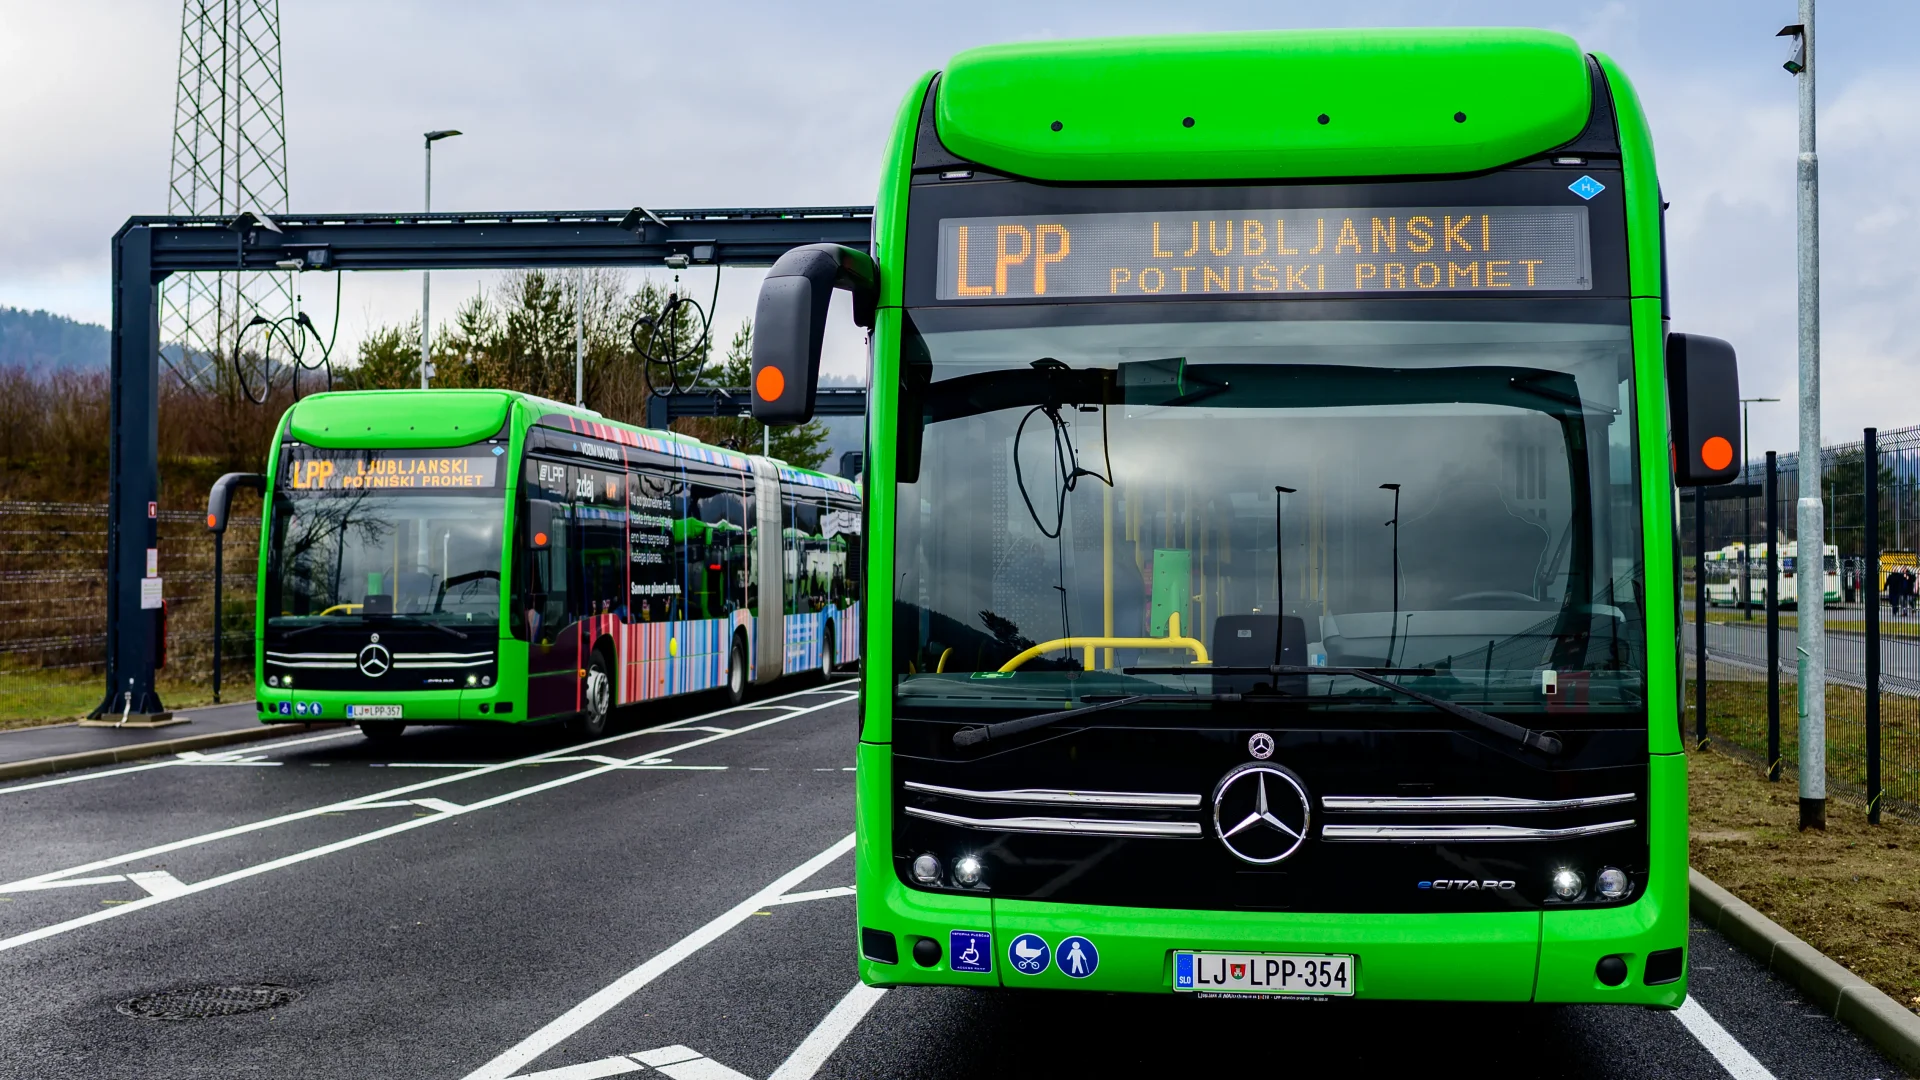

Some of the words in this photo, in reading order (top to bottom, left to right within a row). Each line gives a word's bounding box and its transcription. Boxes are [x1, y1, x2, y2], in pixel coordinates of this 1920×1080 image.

[1153, 214, 1490, 258] LJUBLJANSKI
[957, 224, 1070, 296] LPP
[1110, 259, 1325, 293] POTNIŠKI
[1355, 259, 1543, 289] PROMET
[293, 460, 334, 489] LPP
[357, 459, 468, 476] LJUBLJANSKI
[548, 465, 564, 483] LPP
[343, 474, 415, 488] POTNIŠKI
[422, 475, 484, 487] PROMET
[576, 473, 595, 503] zdaj
[630, 491, 637, 506] To
[631, 532, 639, 544] eno
[631, 581, 645, 595] Samo
[645, 584, 651, 595] en
[651, 581, 666, 597] planet
[353, 707, 365, 716] LJ
[370, 706, 400, 717] LPP-357
[1417, 879, 1516, 891] eCITARO
[1179, 975, 1191, 985] SLO
[1197, 957, 1227, 985] LJ
[1250, 959, 1347, 988] LPP-354
